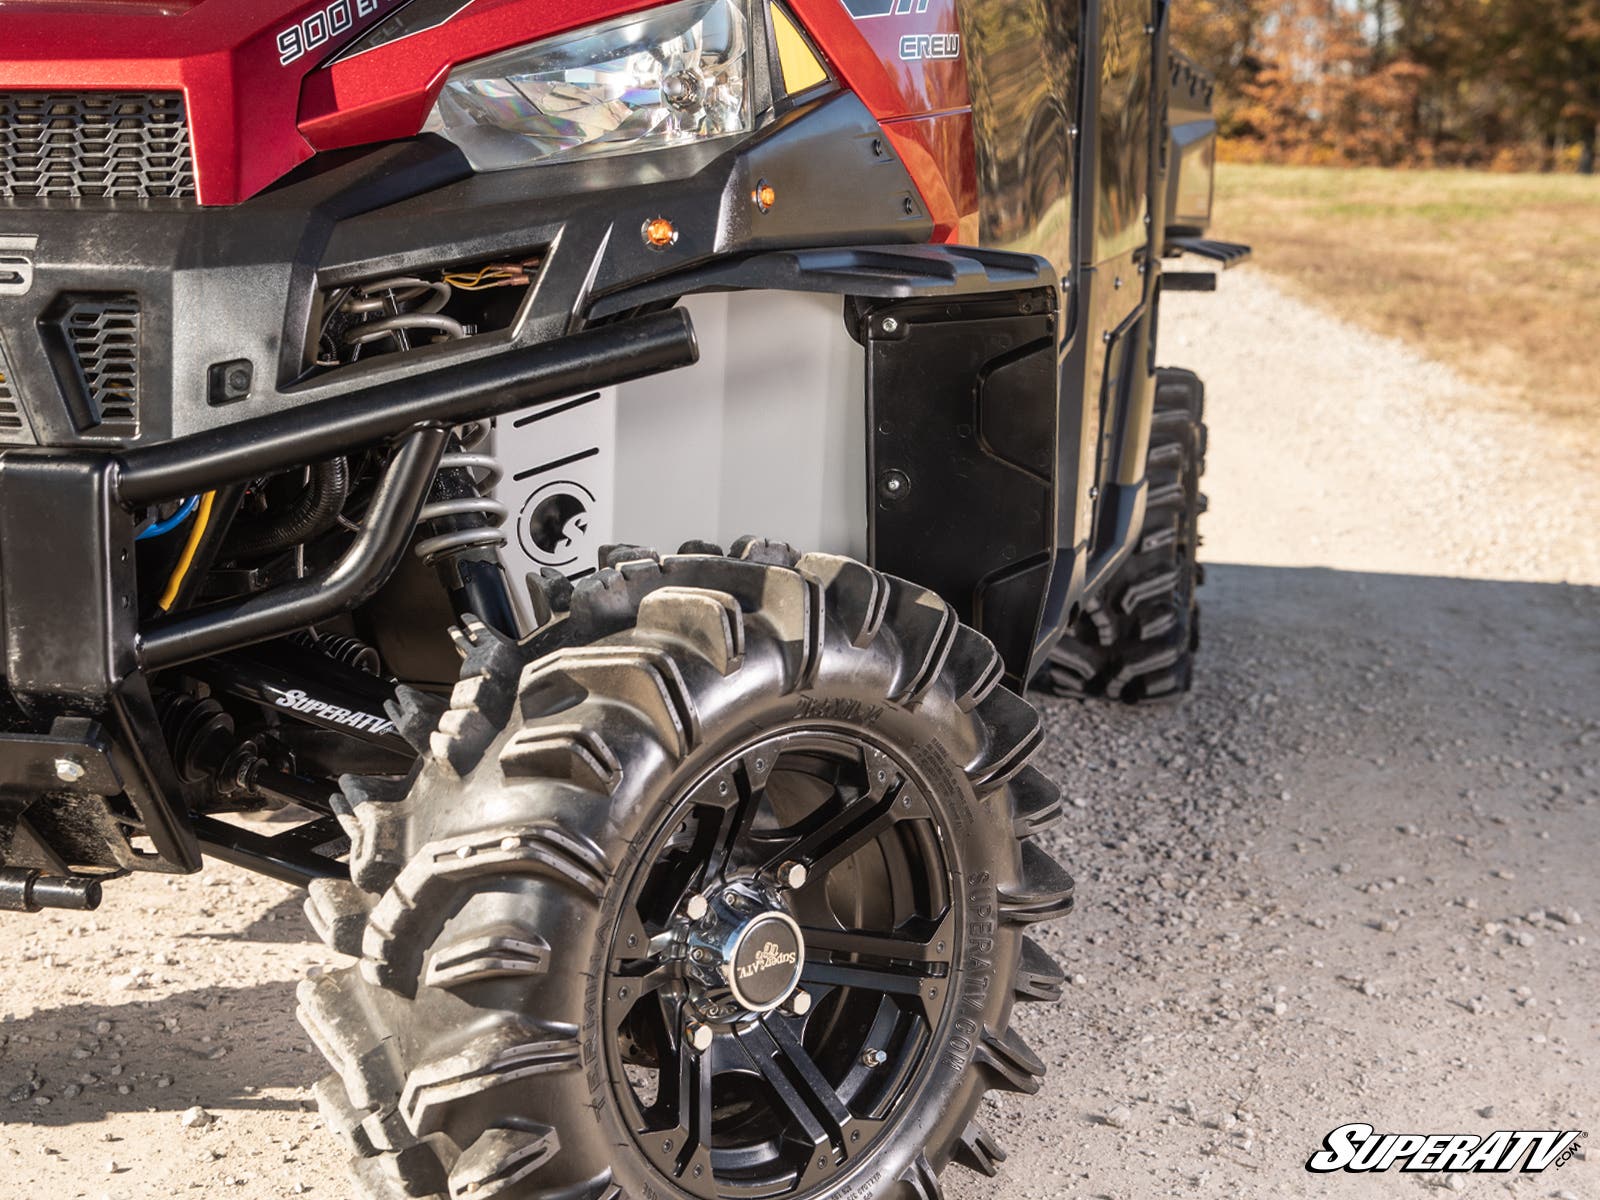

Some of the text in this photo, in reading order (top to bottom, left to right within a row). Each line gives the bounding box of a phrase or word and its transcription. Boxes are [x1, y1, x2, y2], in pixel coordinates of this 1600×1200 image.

[276, 0, 352, 66] 900
[899, 34, 960, 60] CREW
[275, 689, 394, 734] SUPERATV
